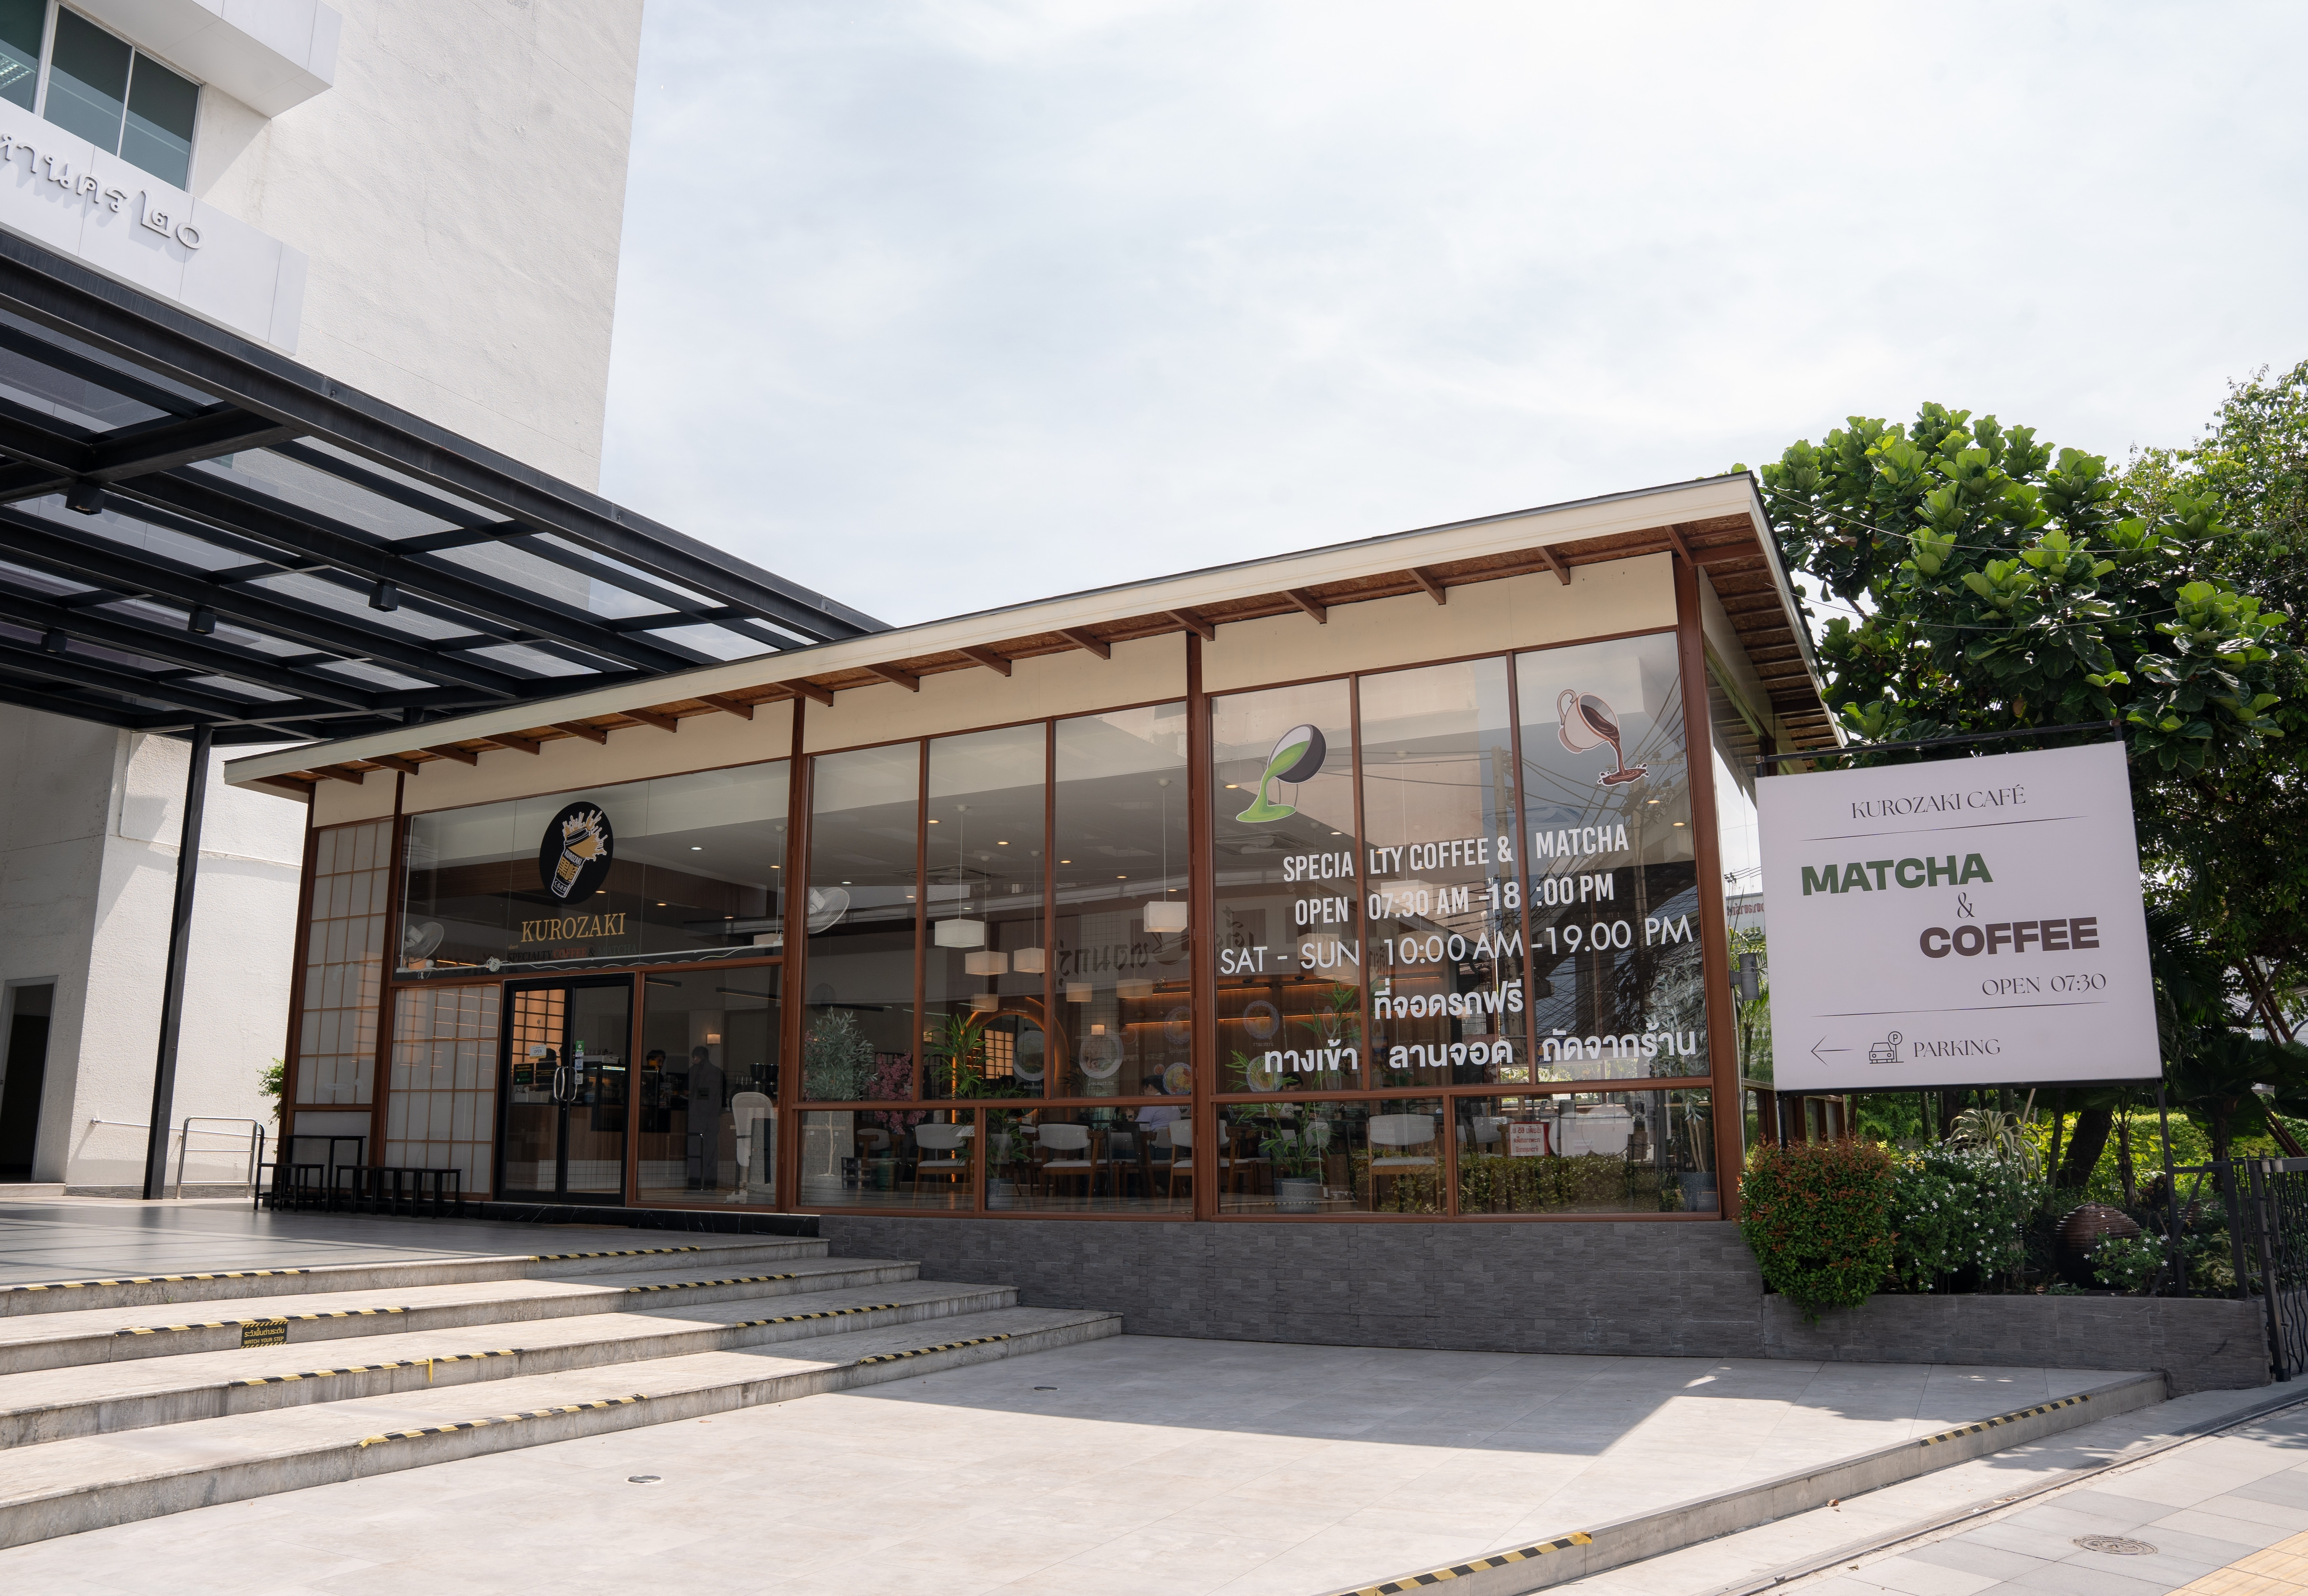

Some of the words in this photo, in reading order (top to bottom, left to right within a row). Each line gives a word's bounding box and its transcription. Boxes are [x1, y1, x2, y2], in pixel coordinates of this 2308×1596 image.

[1851, 793, 1961, 819] KUROZAKI
[1967, 784, 2026, 809] CAFÉ
[564, 849, 583, 865] KUROZAKI
[1283, 851, 1354, 882] SPECIA
[1370, 846, 1403, 875] LTY
[1410, 838, 1489, 871] COFFEE
[1497, 836, 1514, 863] &
[1536, 824, 1629, 859] MATCHA
[1801, 853, 1994, 896] MATCHA
[1295, 897, 1349, 925] OPEN
[1368, 890, 1429, 920] 07:30
[1436, 886, 1469, 914] AM
[1957, 892, 1976, 918] &
[520, 913, 626, 943] KUROZAKI
[1220, 946, 1268, 974] SAT
[1301, 940, 1360, 969] SUN
[1384, 934, 1465, 965] 10:00
[1473, 930, 1524, 960] AM
[1645, 915, 1693, 946] PM
[1920, 917, 2100, 958] COFFEE
[508, 950, 553, 962] SPECIALTY
[553, 947, 587, 959] COFFEE
[588, 947, 595, 957] &
[598, 944, 637, 956] MATCHA
[1375, 978, 1523, 1019] ที่จอดรถฟรี
[1982, 977, 2041, 996] OPEN
[2050, 973, 2106, 992] 07:30
[1265, 1039, 1358, 1073] ทางเข้า
[1389, 1040, 1513, 1069] ลานจอด
[1542, 1023, 1696, 1061] ถัดจากร้าน
[1913, 1039, 2000, 1057] PARKING
[244, 1327, 285, 1337] ระวังพื้นต่างระดับ
